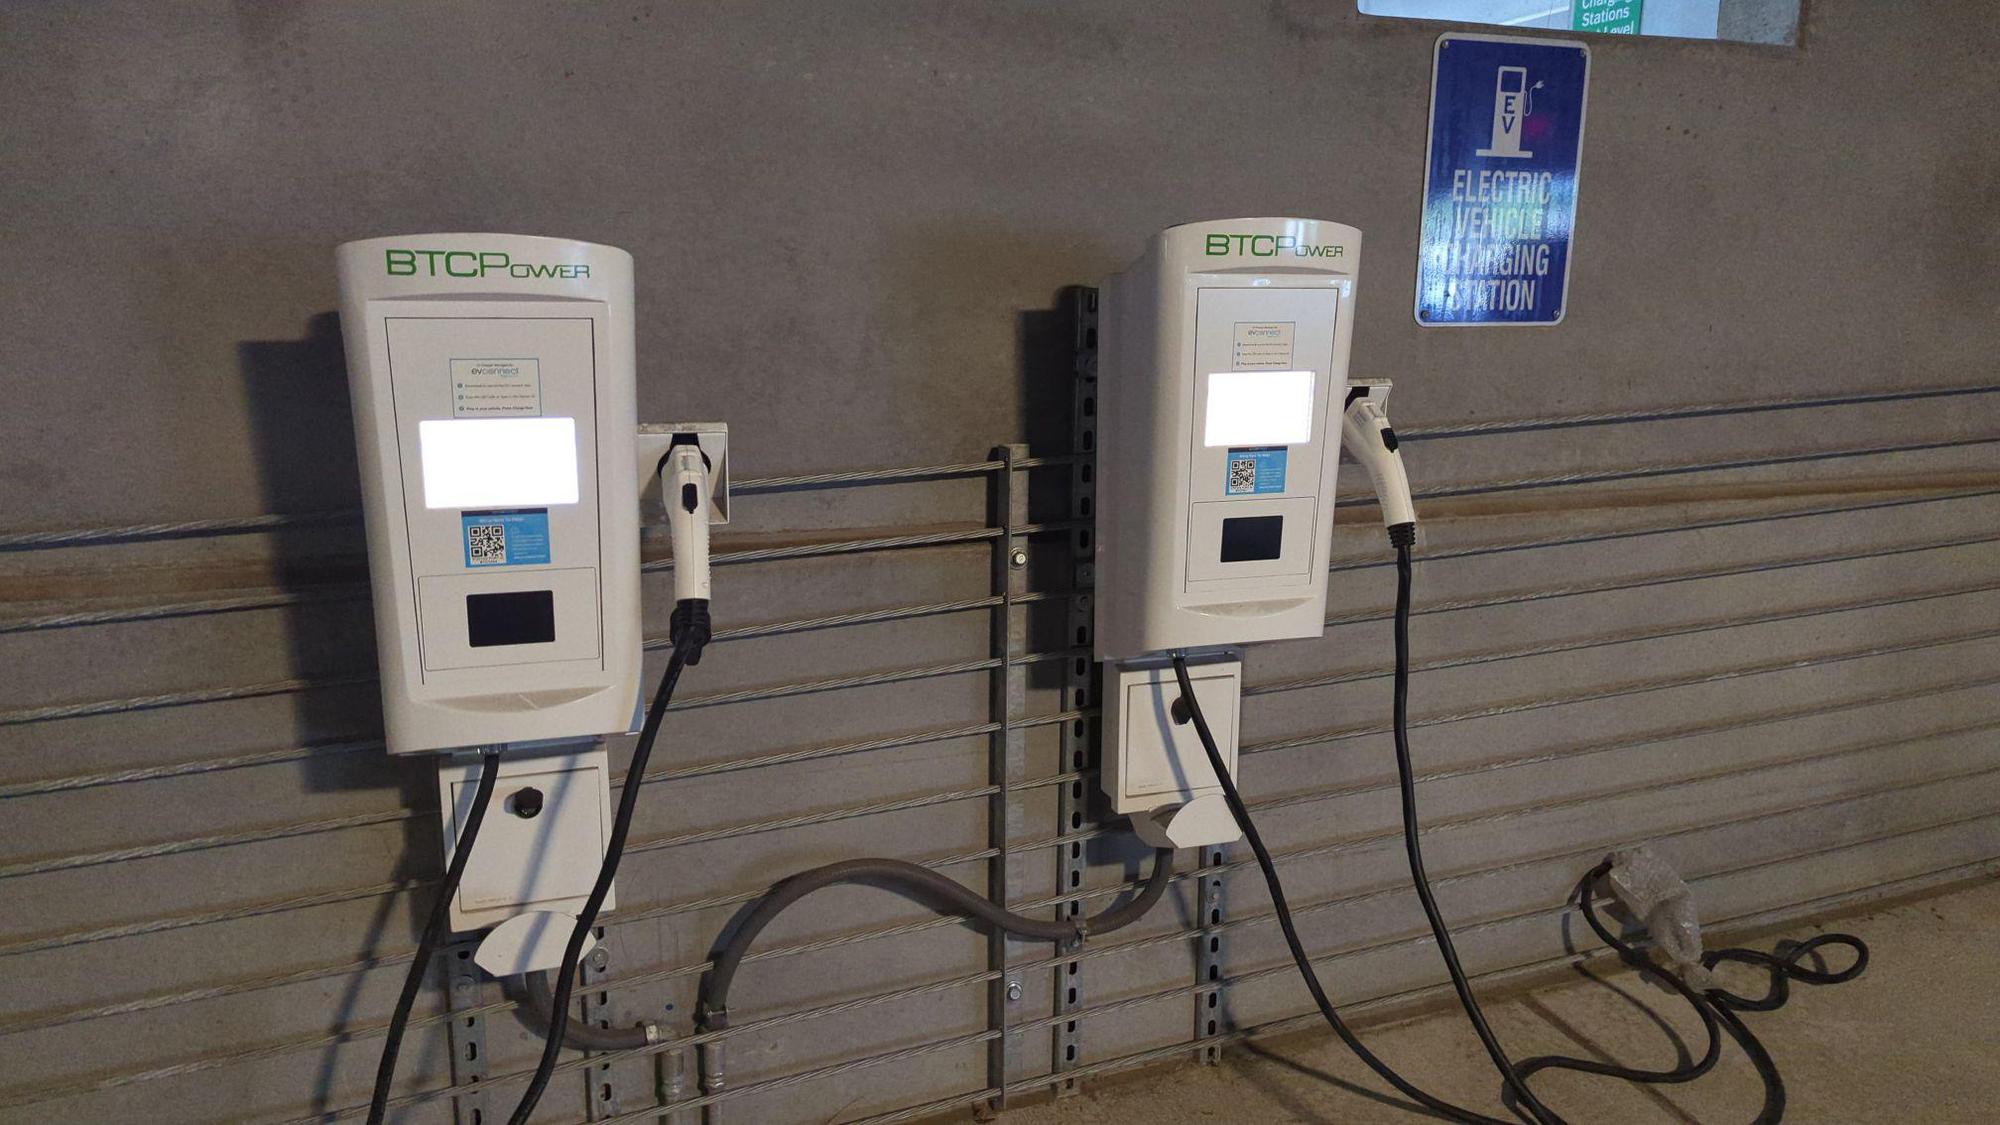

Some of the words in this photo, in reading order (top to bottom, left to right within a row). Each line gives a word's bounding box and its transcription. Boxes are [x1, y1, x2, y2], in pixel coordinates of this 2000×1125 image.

[1582, 7, 1630, 27] Stations
[1453, 169, 1552, 204] ELECTRIC
[1456, 207, 1543, 240] VEHICLE
[1446, 243, 1550, 276] CHARGING
[1449, 279, 1536, 311] STATION
